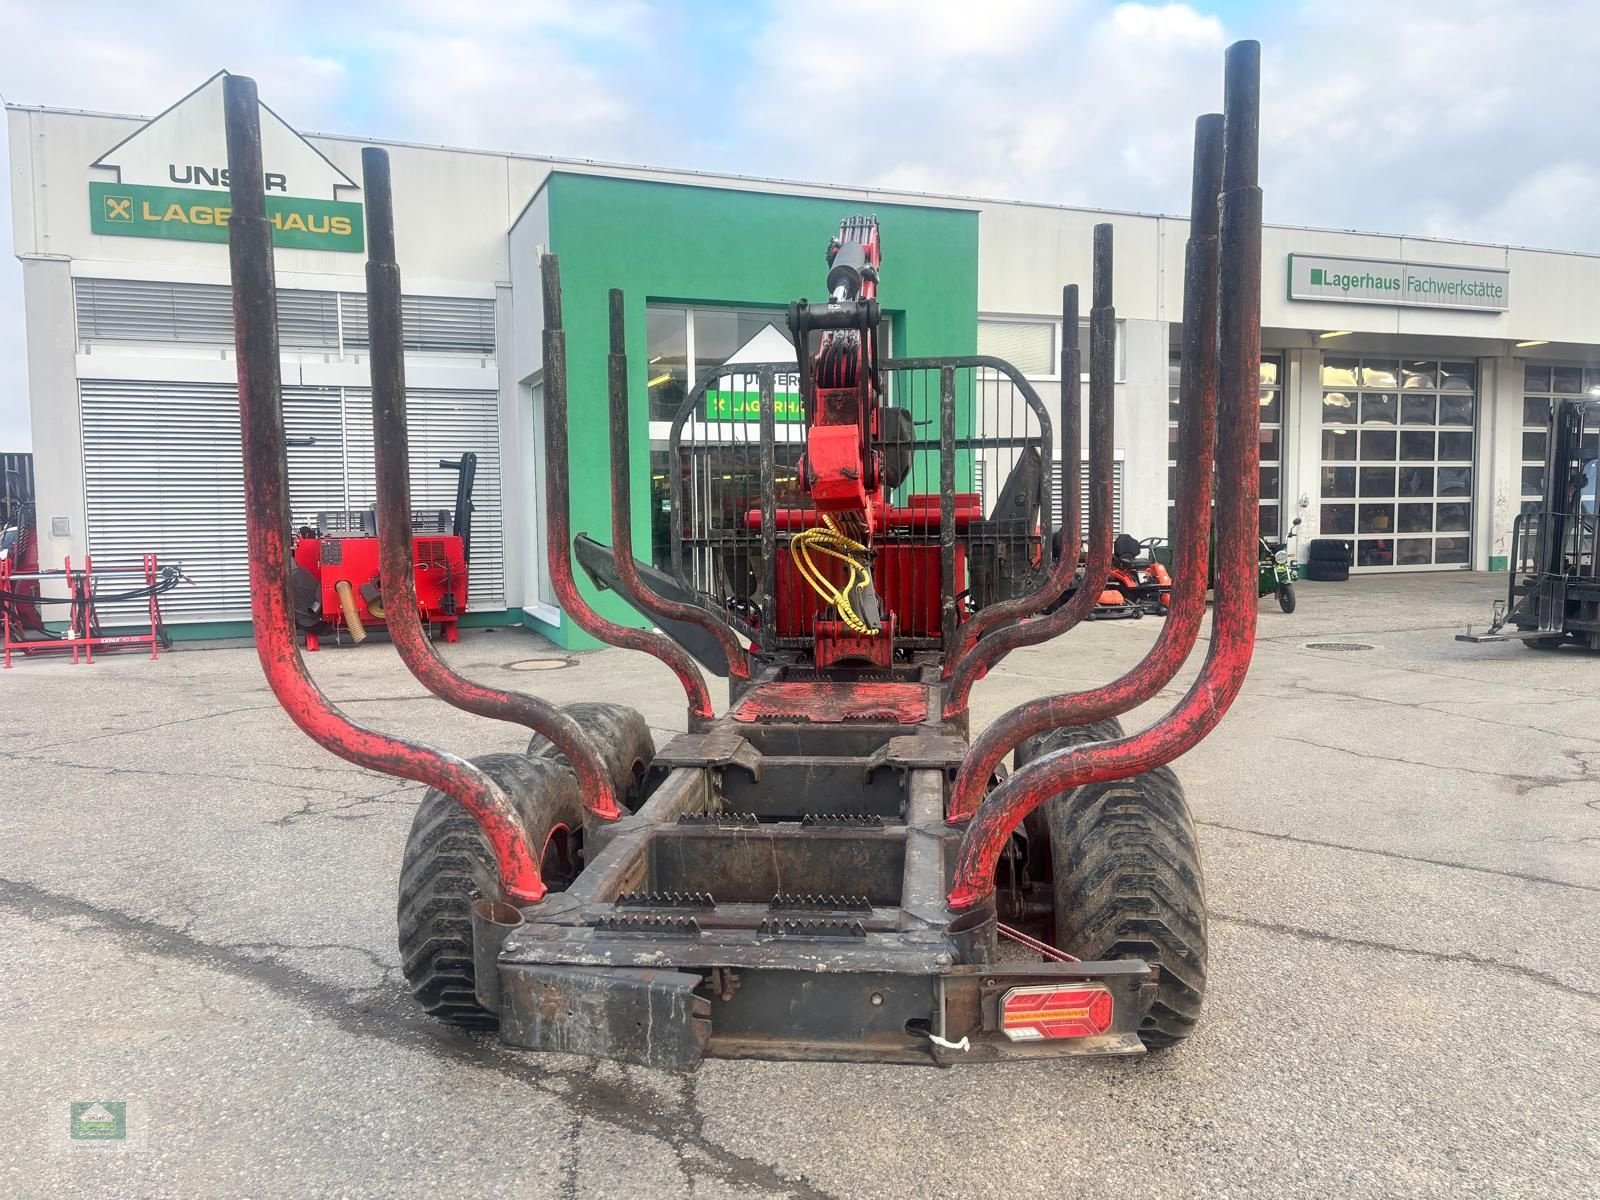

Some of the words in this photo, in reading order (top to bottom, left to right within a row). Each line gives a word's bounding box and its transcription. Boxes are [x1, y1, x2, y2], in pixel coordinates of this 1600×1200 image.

[169, 164, 287, 192] UNSR
[143, 201, 352, 235] LAGEHAUS
[1323, 269, 1401, 291] Lagerhaus
[1407, 276, 1503, 298] Fachwerkstätte
